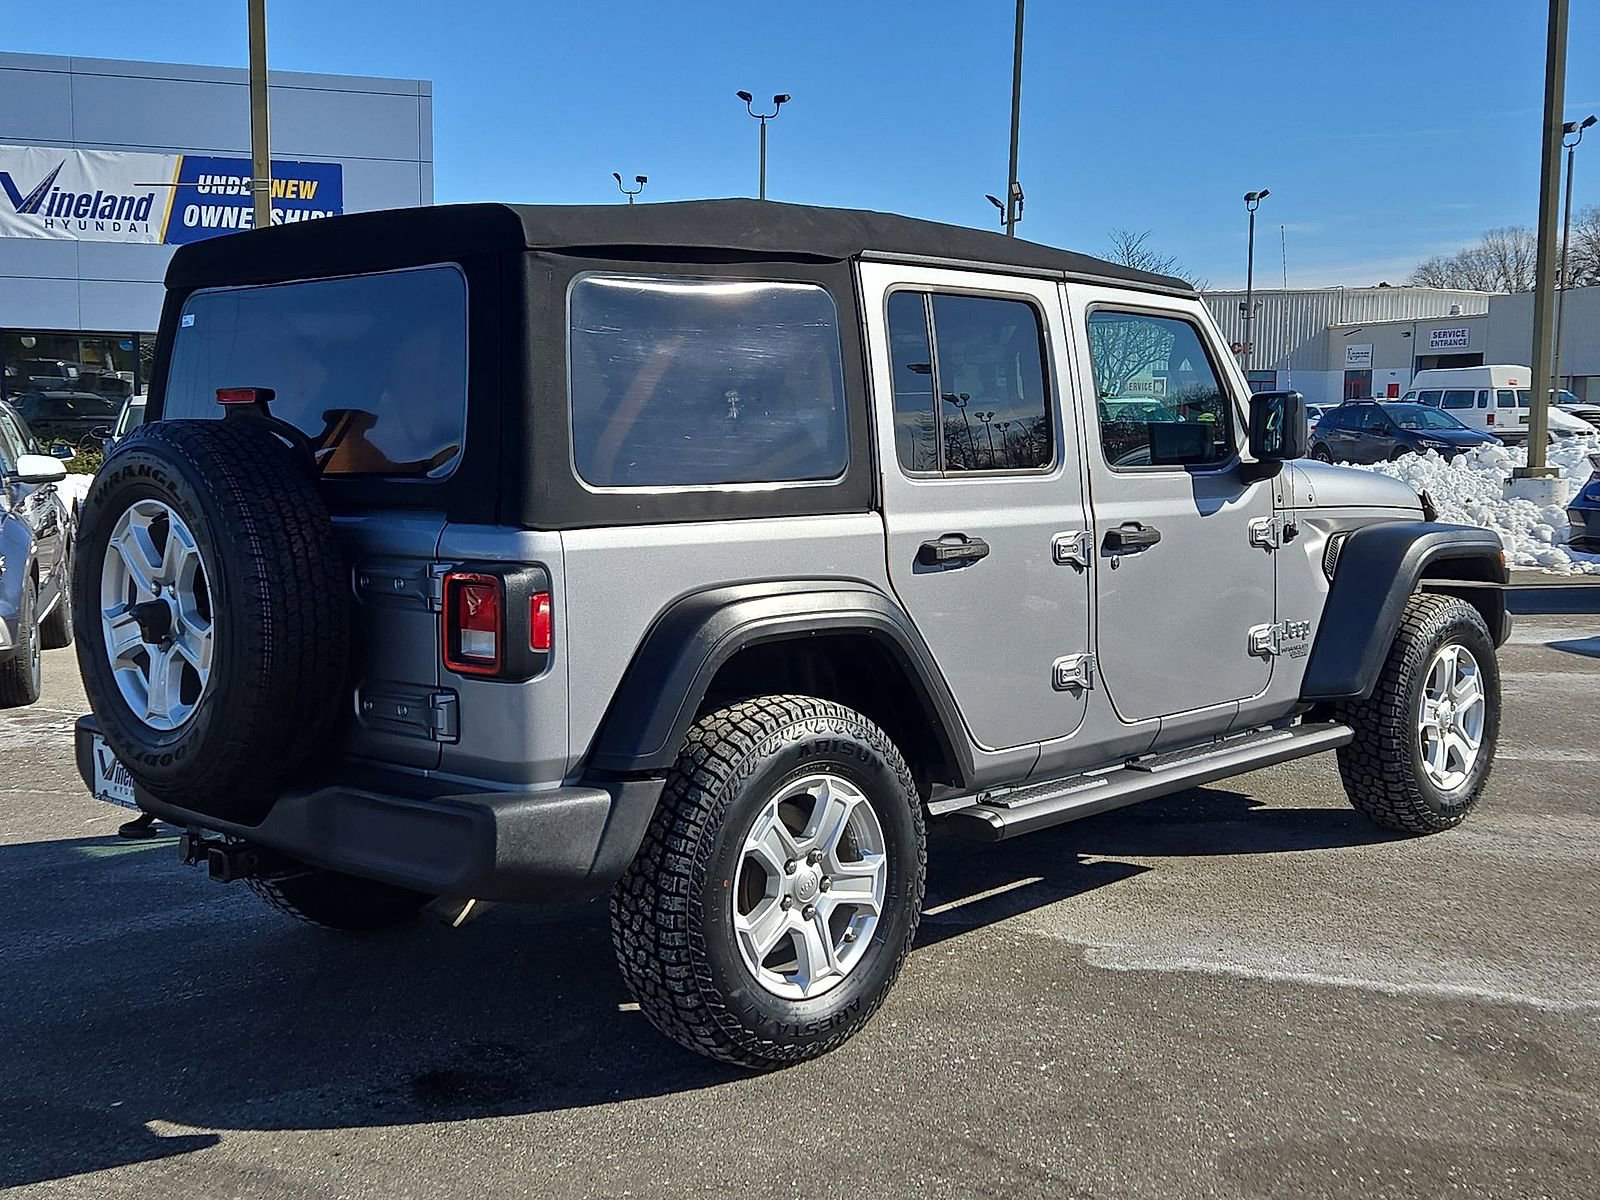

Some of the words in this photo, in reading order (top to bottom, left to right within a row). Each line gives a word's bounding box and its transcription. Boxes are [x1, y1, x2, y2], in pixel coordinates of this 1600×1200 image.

[0, 159, 155, 222] Vineland
[197, 174, 253, 196] UNDE
[270, 178, 319, 200] NEW
[45, 218, 149, 233] HYUNDAI
[1430, 338, 1468, 348] ENTRANCE
[1432, 329, 1467, 339] SERVICE
[1280, 618, 1311, 640] Jeep
[775, 997, 861, 1038] ARESTA
